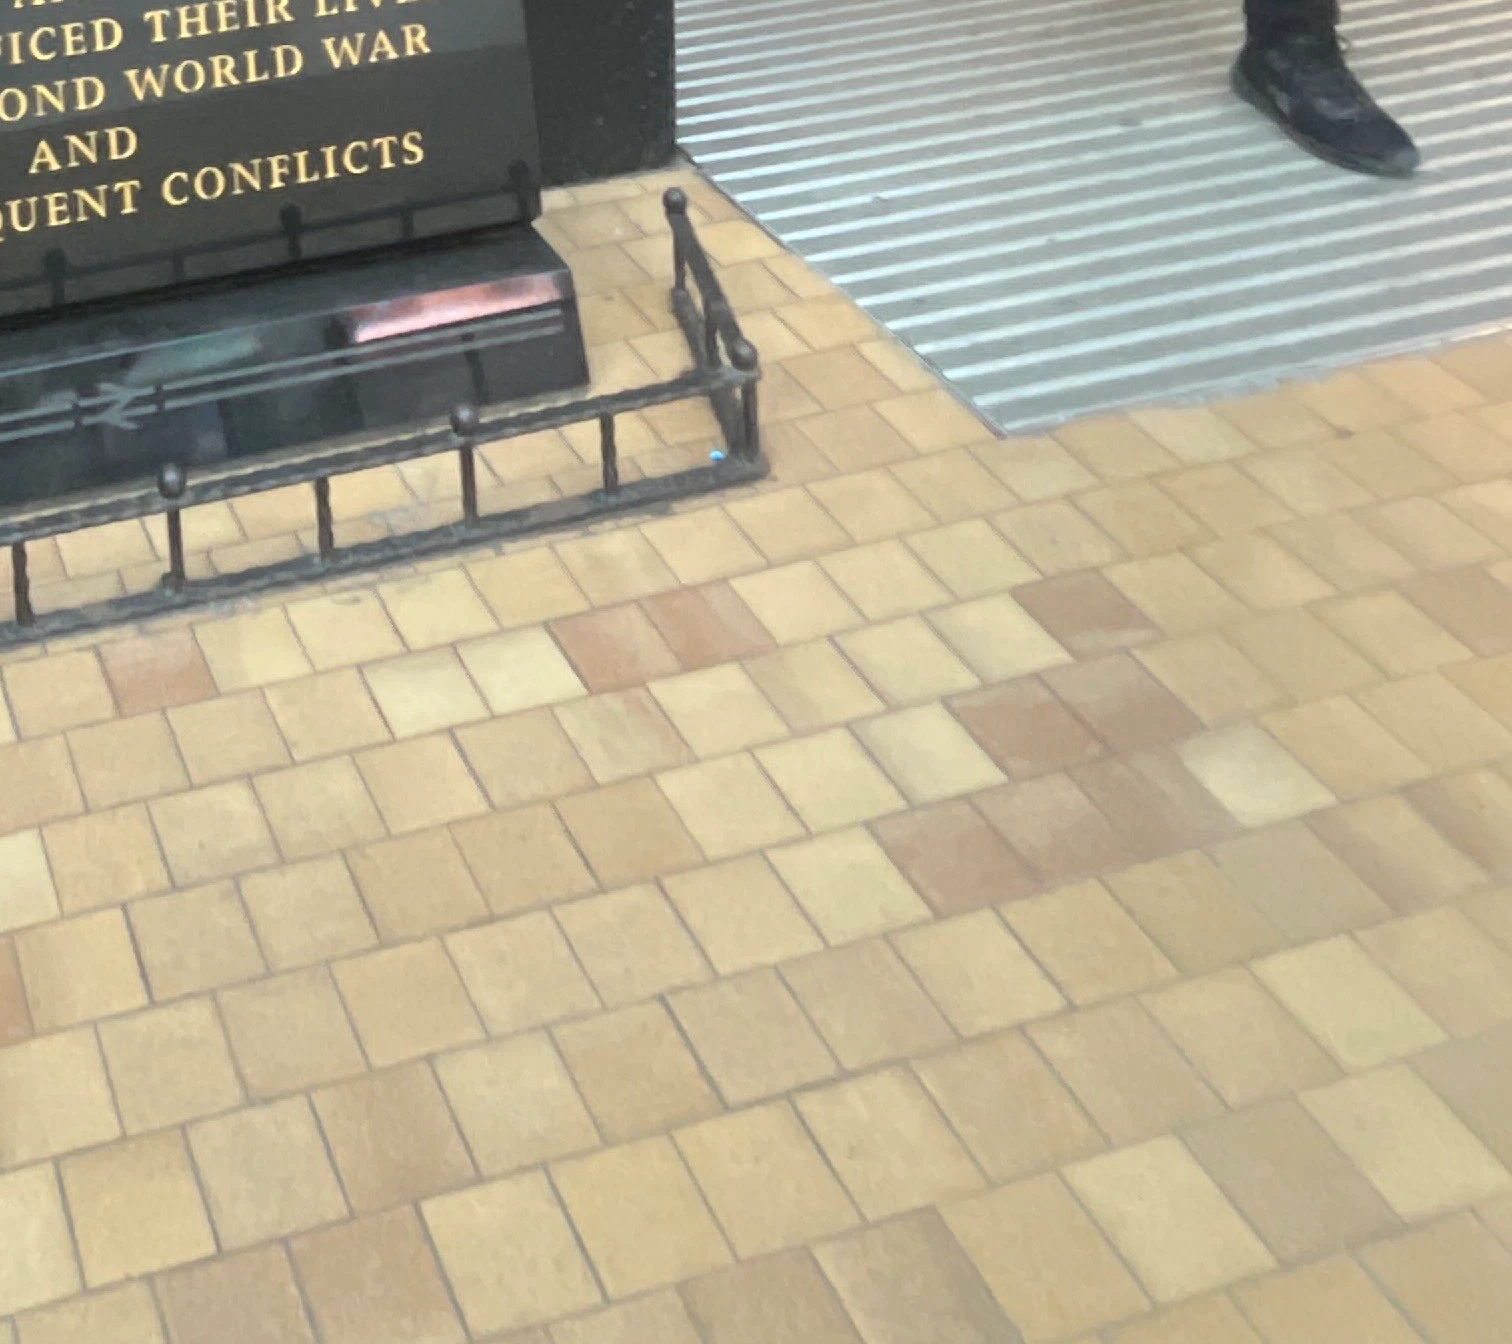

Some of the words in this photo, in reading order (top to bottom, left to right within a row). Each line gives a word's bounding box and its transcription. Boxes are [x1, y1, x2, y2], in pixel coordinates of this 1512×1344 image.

[124, 44, 305, 102] WORLD
[321, 23, 432, 70] WAR
[28, 125, 140, 175] AND
[161, 130, 426, 207] CONFLICTS
